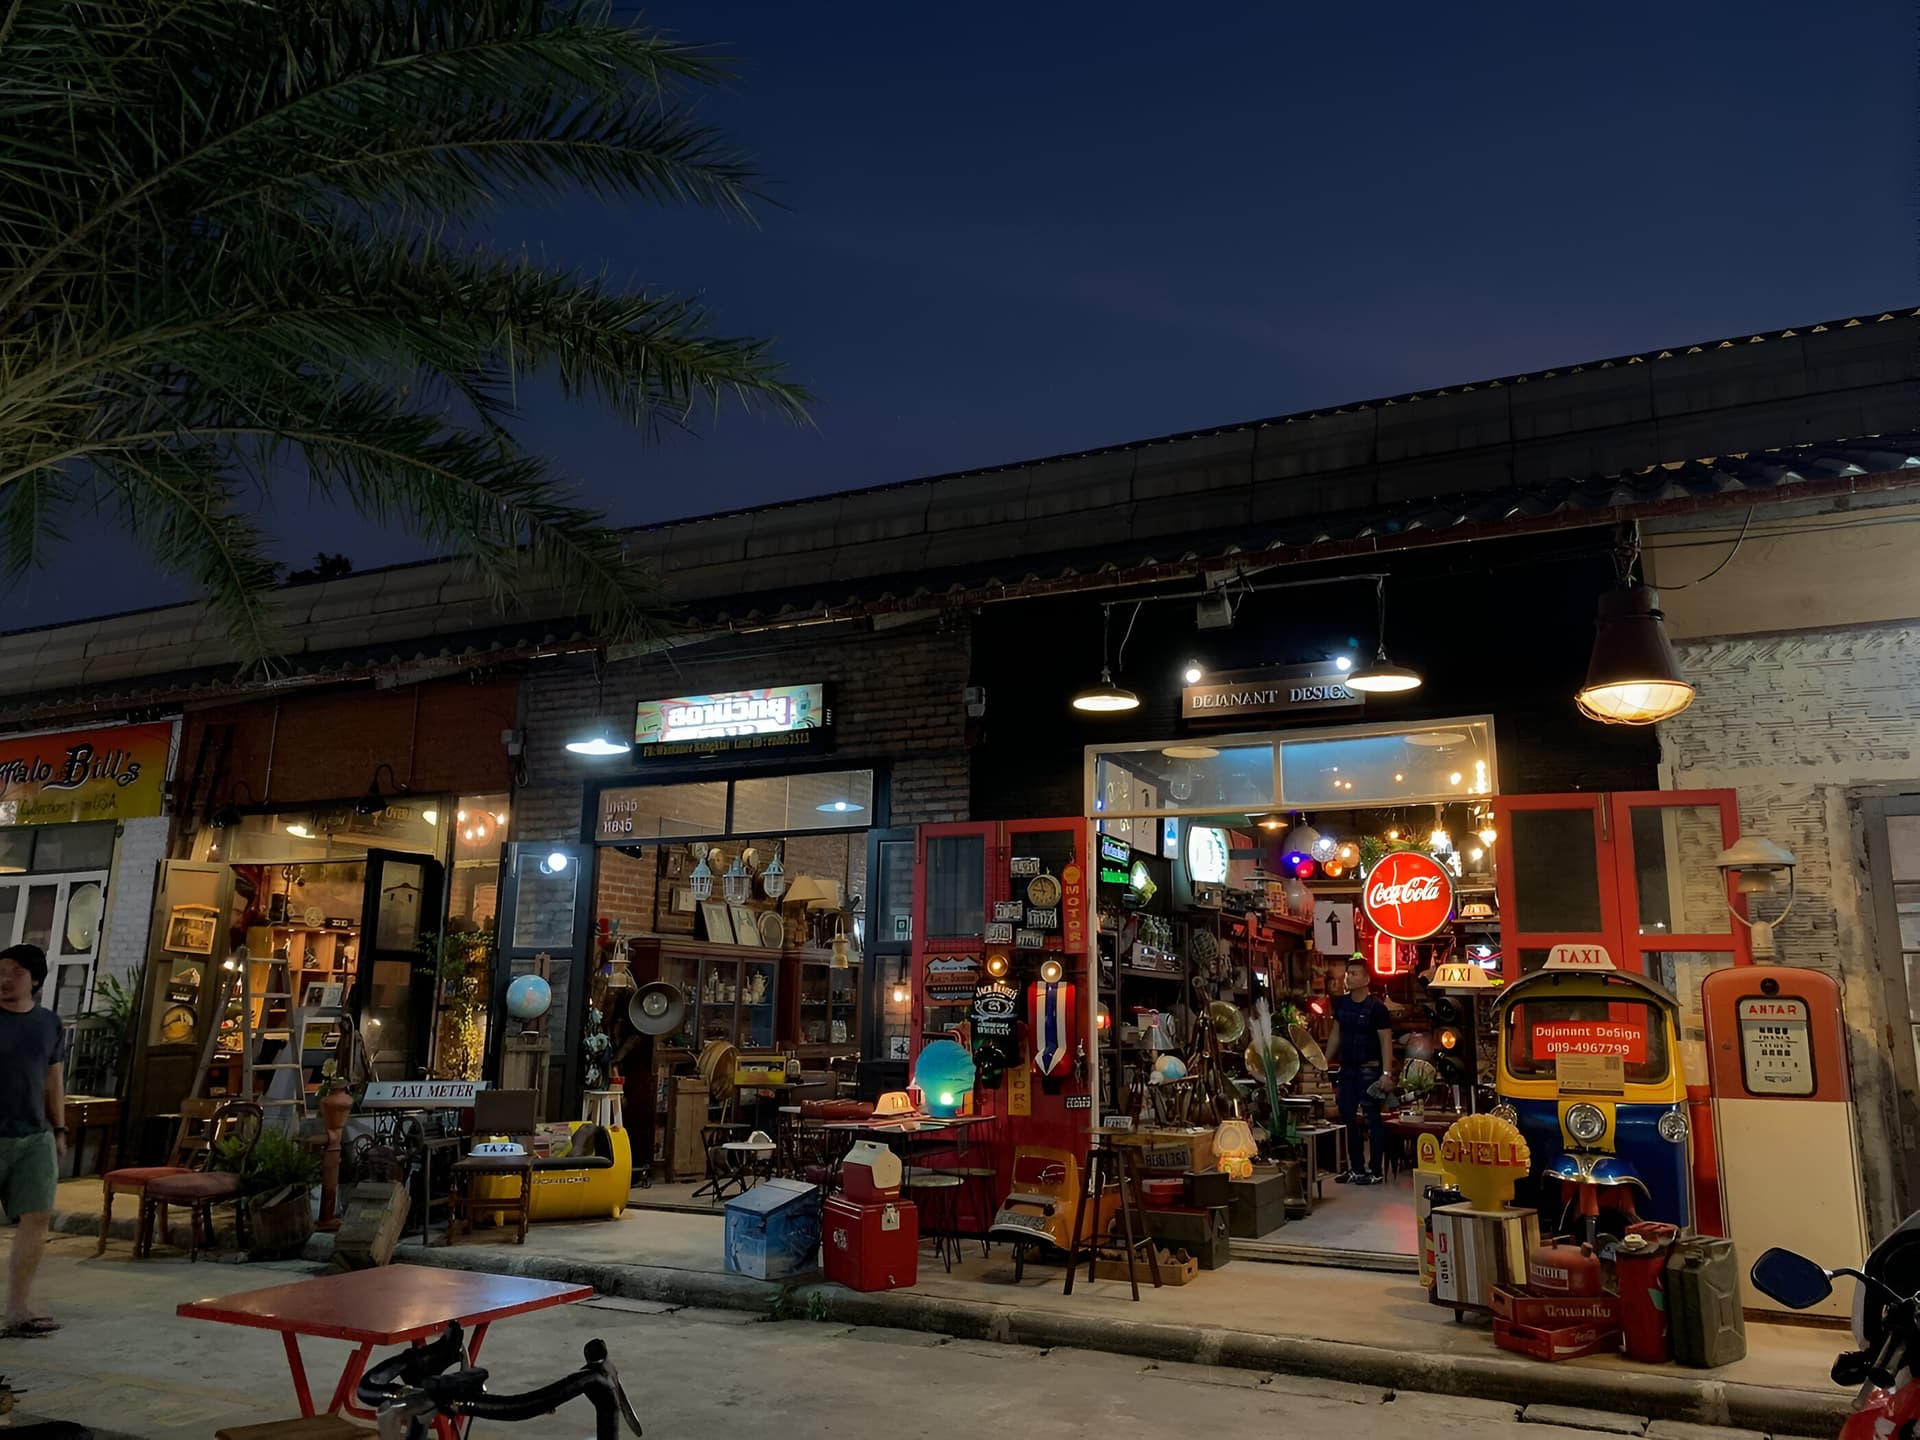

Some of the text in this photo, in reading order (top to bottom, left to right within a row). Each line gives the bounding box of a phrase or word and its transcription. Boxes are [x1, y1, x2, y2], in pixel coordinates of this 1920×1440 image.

[42, 743, 141, 790] Bill's
[1557, 949, 1601, 964] TAXI
[1440, 967, 1471, 982] TAXI
[391, 1084, 474, 1098] TAXI METER
[483, 1144, 514, 1153] TAXI
[1442, 1140, 1527, 1166] SHELL
